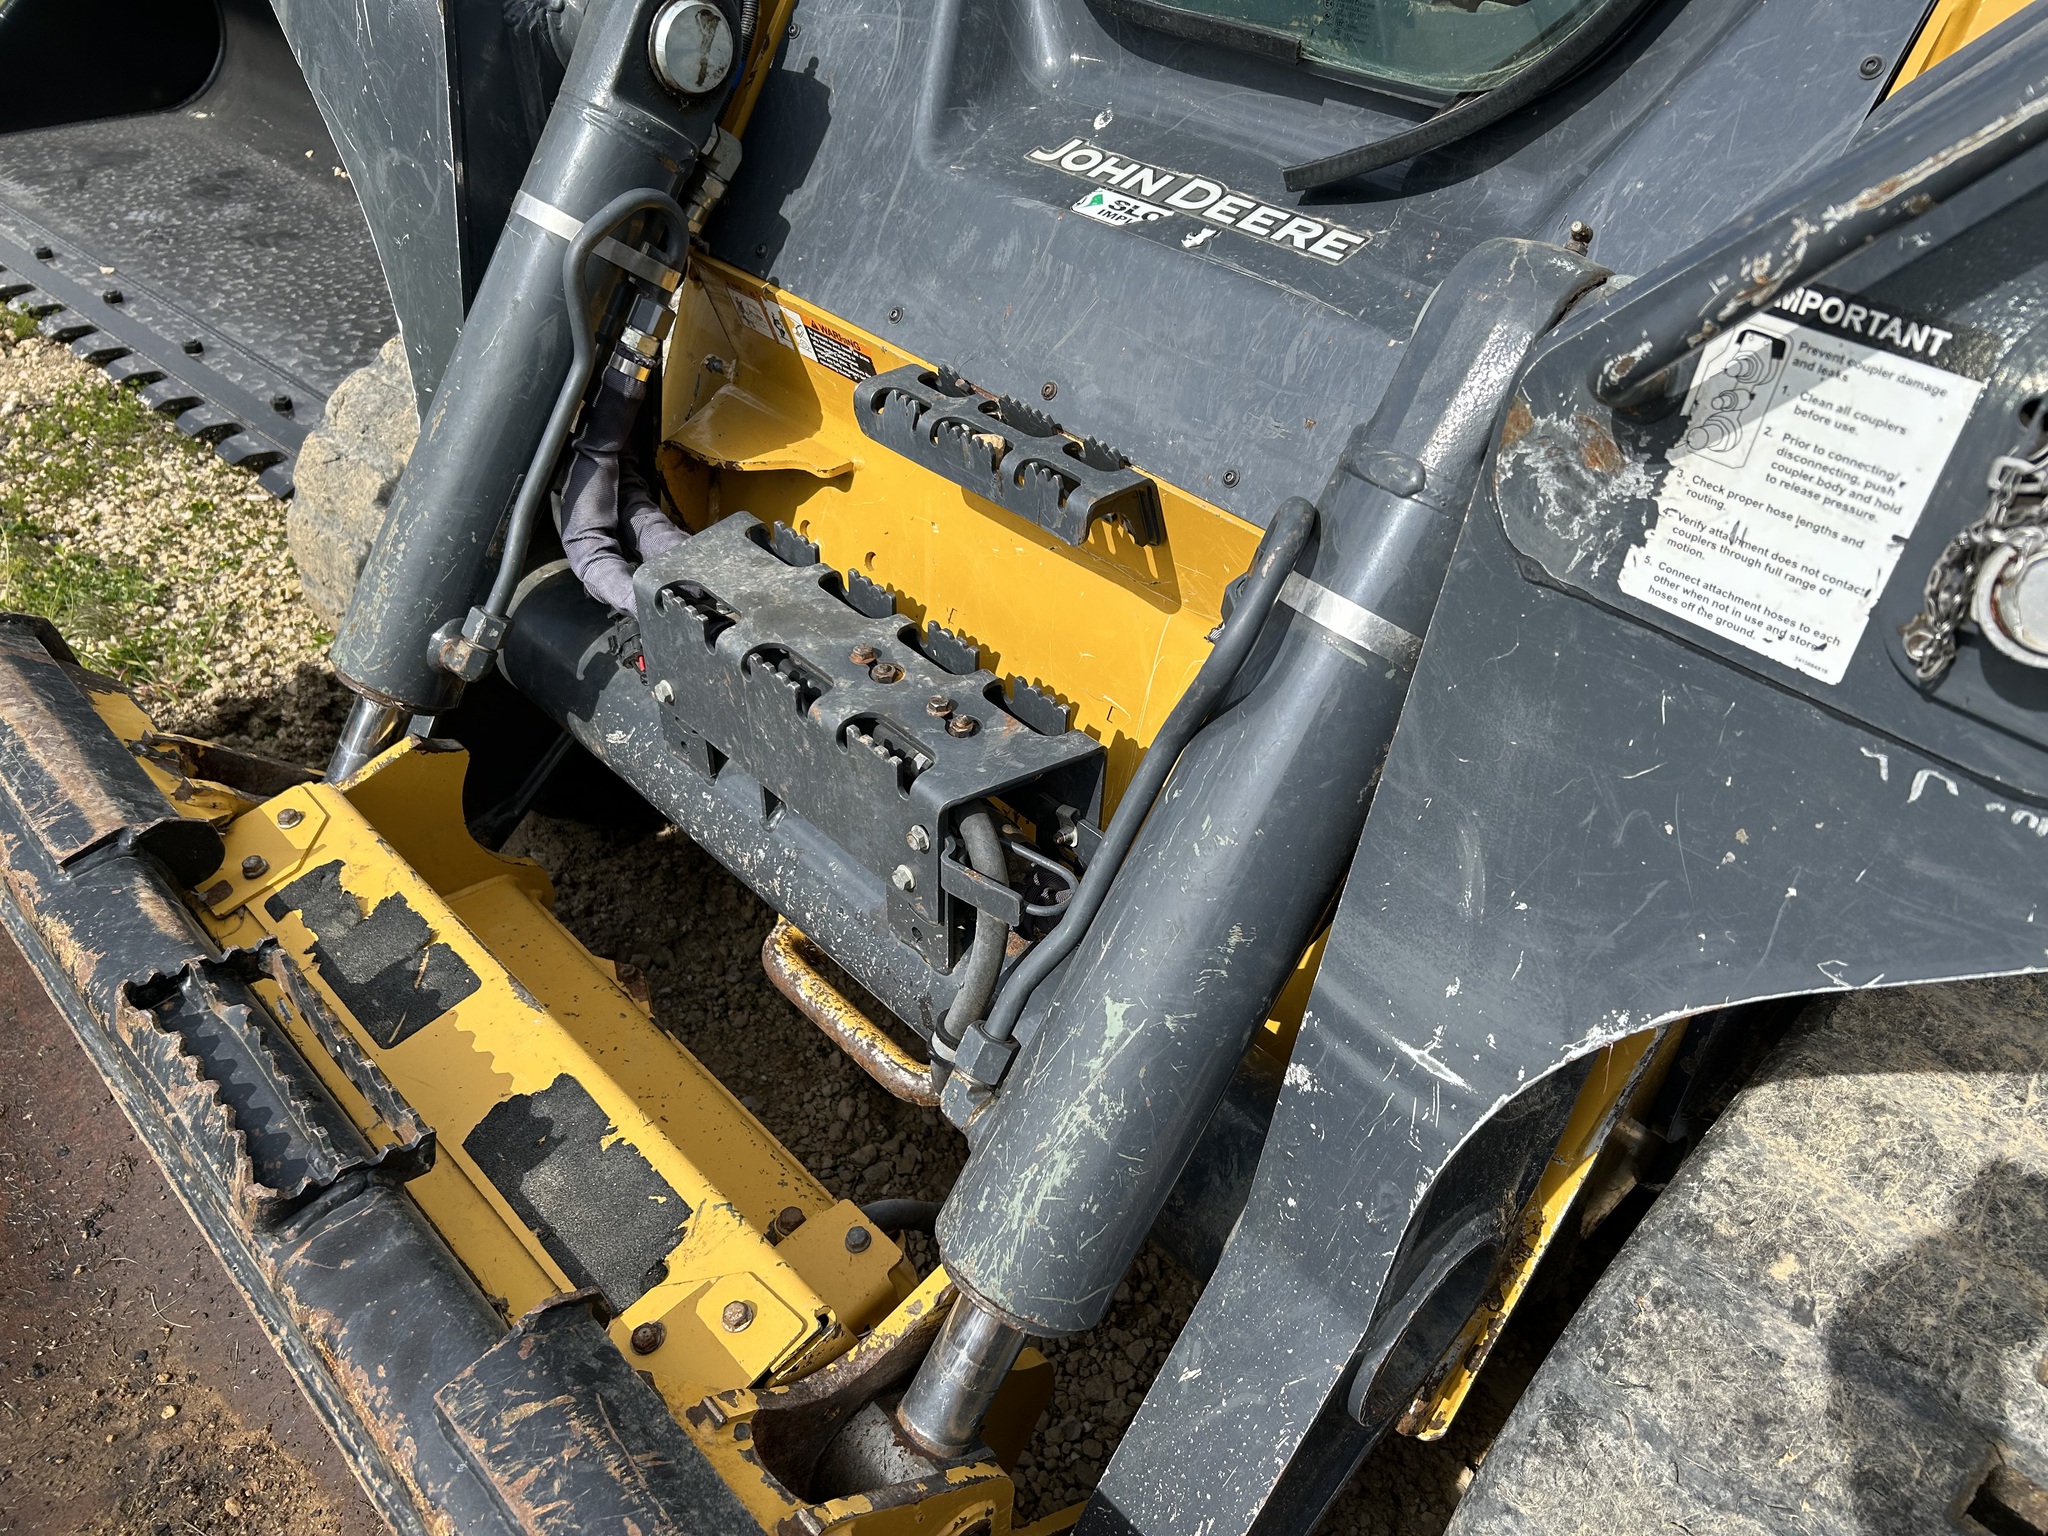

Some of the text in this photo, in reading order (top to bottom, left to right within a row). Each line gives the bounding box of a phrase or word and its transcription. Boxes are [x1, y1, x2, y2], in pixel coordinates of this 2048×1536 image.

[1030, 138, 1366, 261] JOHN DEERE
[1774, 287, 1953, 357] MPORTANT
[1792, 358, 1848, 381] and leaks
[1798, 341, 1948, 396] Prevent coupler damage
[1782, 385, 1907, 434] 1. Clean all couplers
[1793, 404, 1859, 434] before use.
[1763, 426, 1900, 481] 2. Prior to connecting/
[1676, 467, 1865, 548] 3. Check proper hose lengths and
[1686, 488, 1726, 510] routing.
[1765, 472, 1878, 521] to release pressure.
[1770, 461, 1903, 514] coupler body and hold
[1863, 480, 1896, 496] push
[1666, 538, 1705, 559] motion.
[1672, 526, 1833, 596] couplers through full range of
[1678, 511, 1708, 532] Verify
[1770, 552, 1798, 568] does
[1800, 564, 1820, 577] not
[1643, 555, 1841, 646] 5. Connect attachment hoses to each
[1648, 584, 1755, 639] hoses off the ground.
[1653, 575, 1681, 590] other
[1682, 587, 1710, 603] when
[1711, 600, 1730, 612] not
[1731, 607, 1742, 617] in
[1744, 614, 1764, 627] use
[1765, 624, 1788, 639] and
